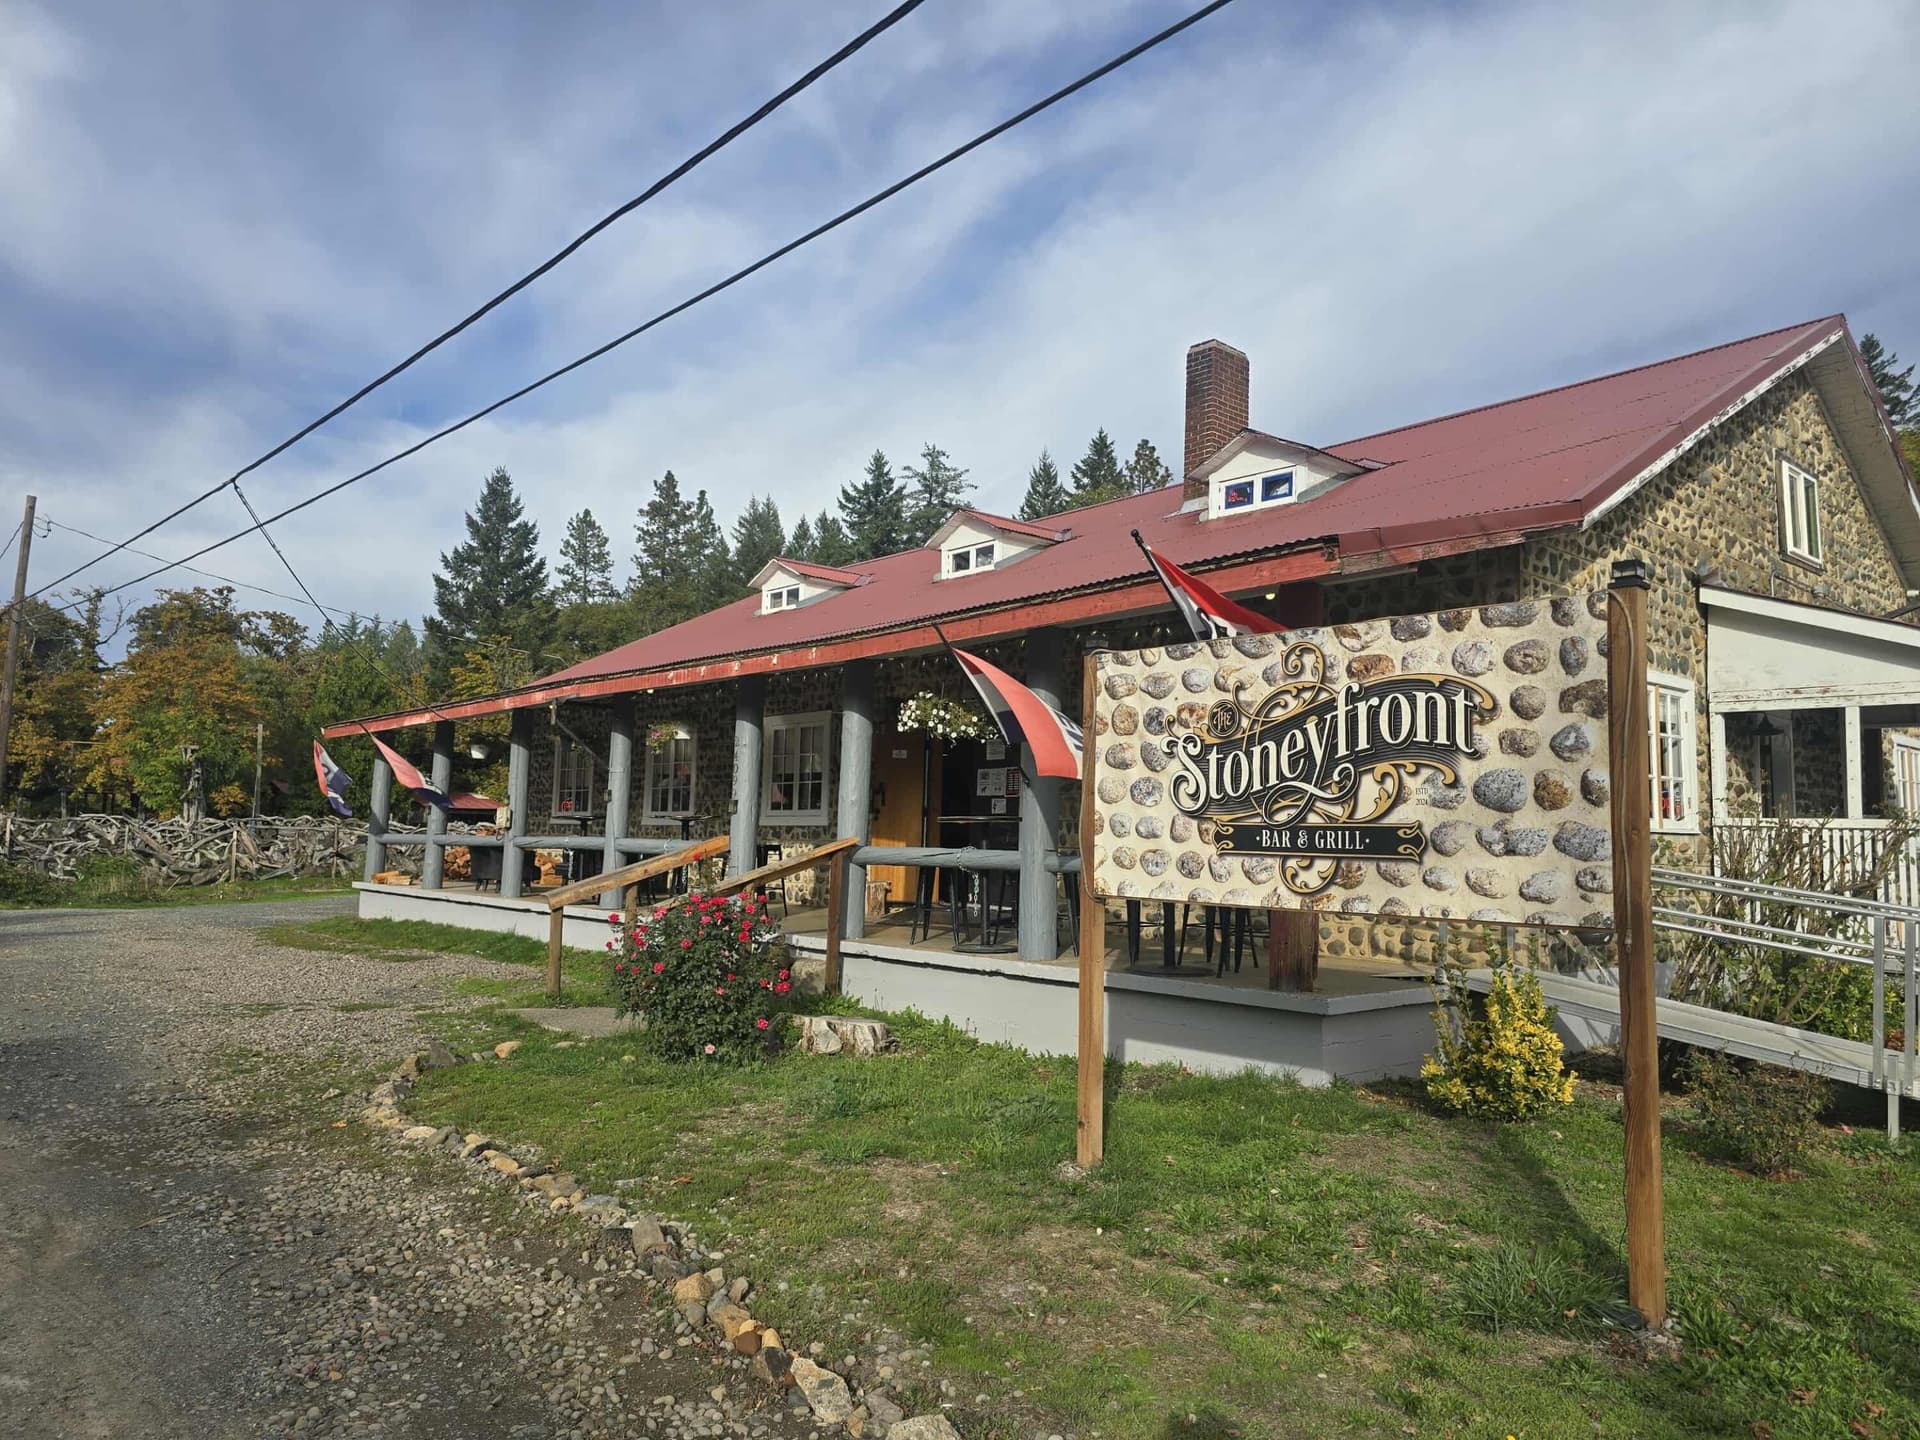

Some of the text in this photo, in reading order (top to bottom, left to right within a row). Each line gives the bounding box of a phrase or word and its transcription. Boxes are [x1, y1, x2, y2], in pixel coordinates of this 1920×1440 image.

[1213, 704, 1233, 732] THE
[1161, 683, 1476, 829] Stoneyfront
[1262, 829, 1364, 850] BAR & GRILL
